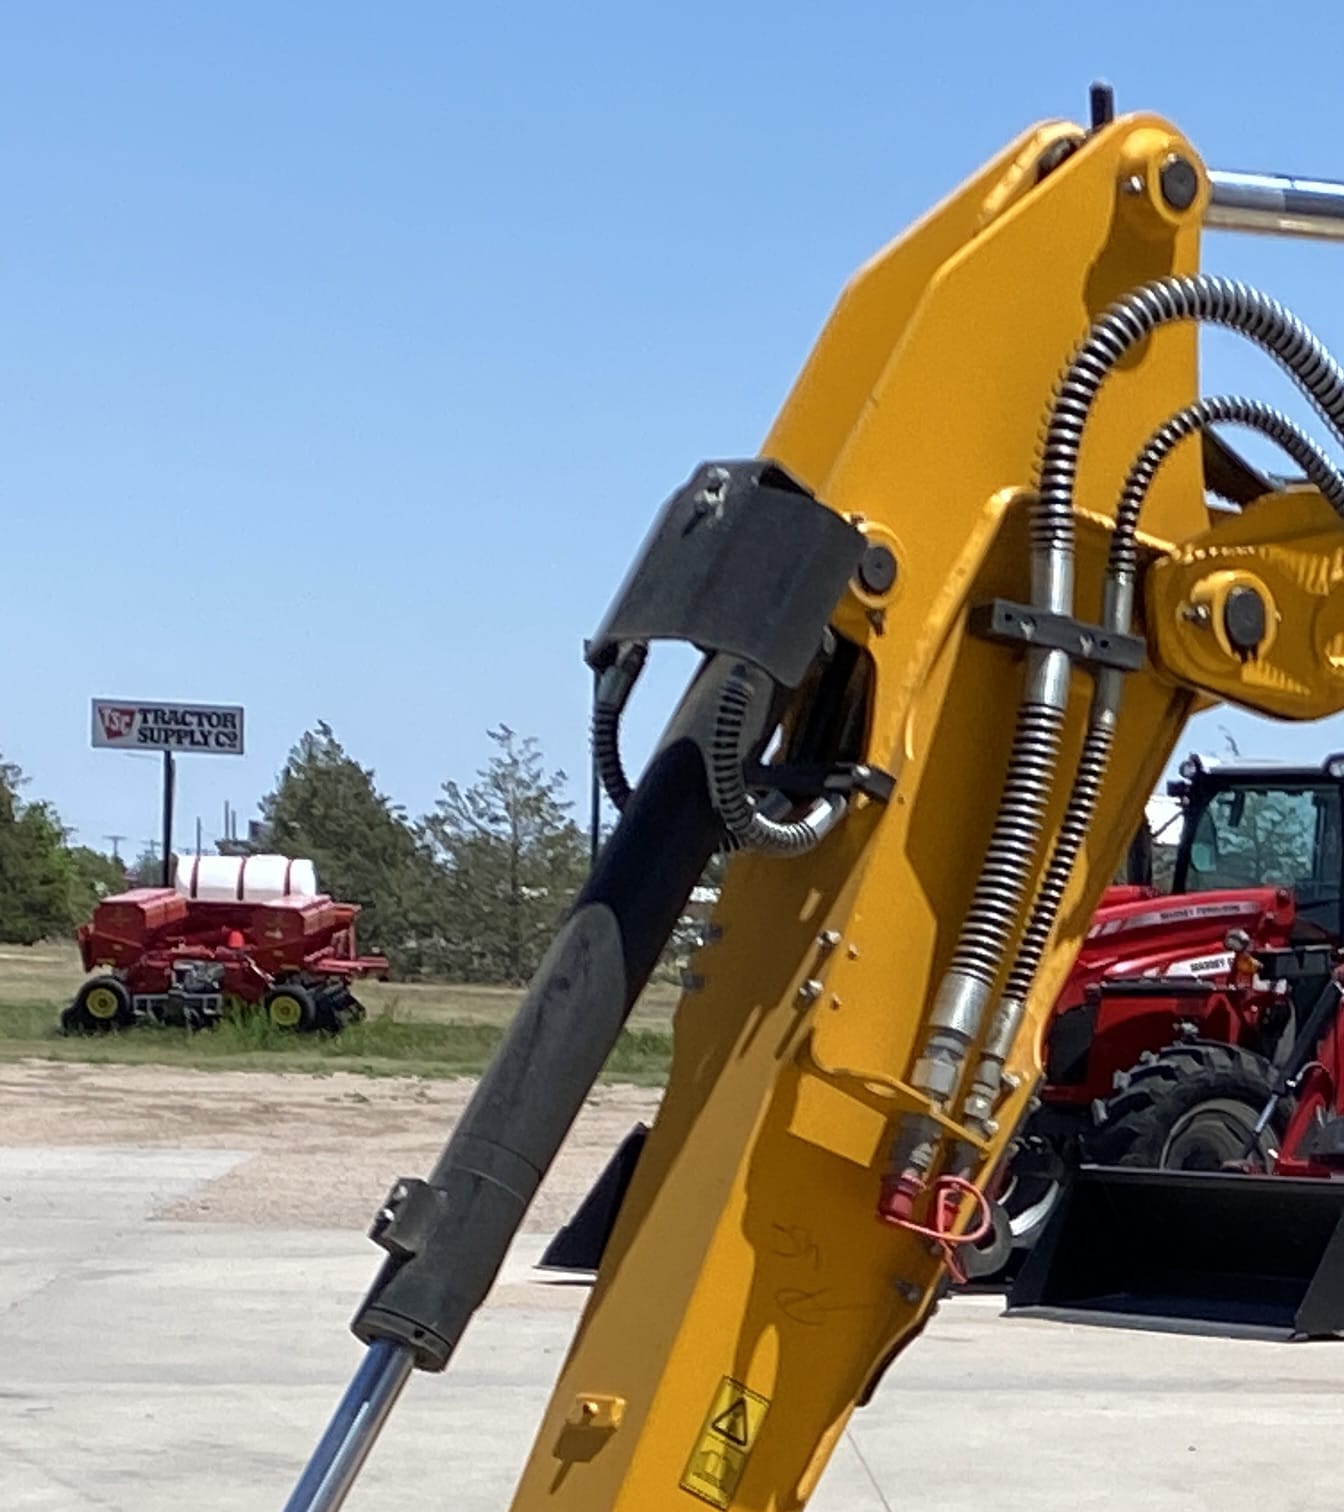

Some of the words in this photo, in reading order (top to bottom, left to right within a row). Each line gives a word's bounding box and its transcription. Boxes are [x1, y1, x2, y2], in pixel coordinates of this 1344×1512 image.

[101, 708, 132, 735] TSC
[137, 707, 237, 729] TRACTOR
[137, 727, 213, 748] SUPPLY
